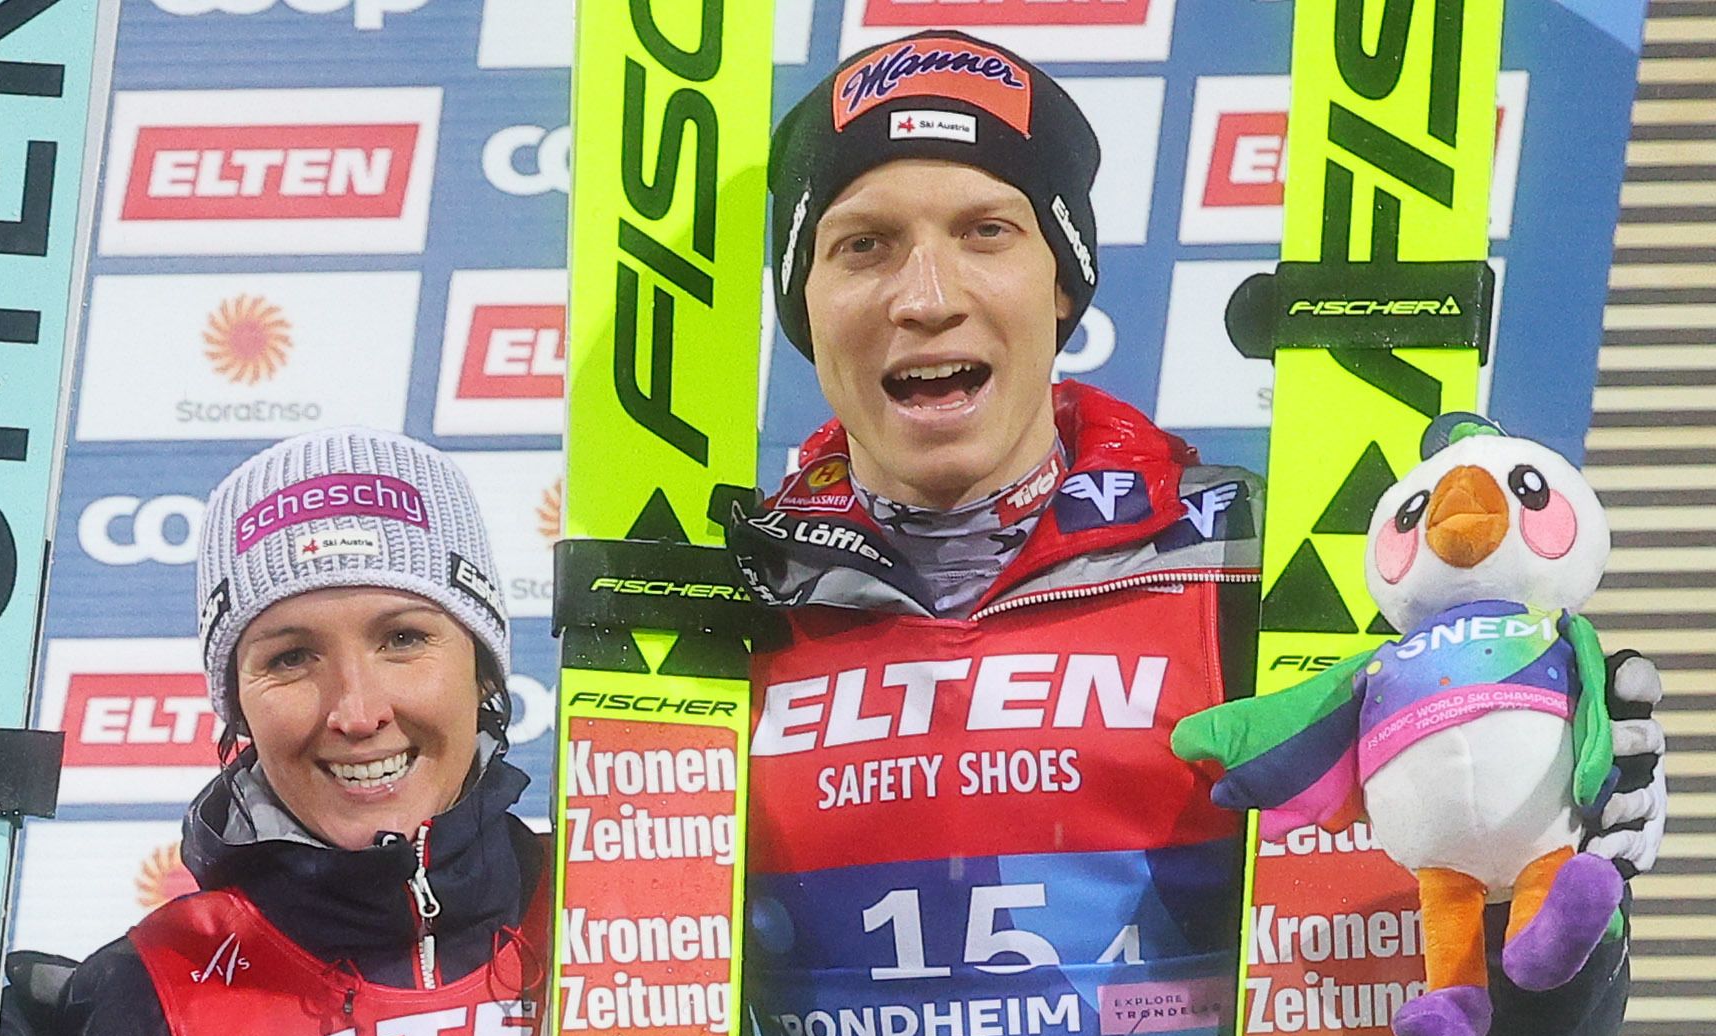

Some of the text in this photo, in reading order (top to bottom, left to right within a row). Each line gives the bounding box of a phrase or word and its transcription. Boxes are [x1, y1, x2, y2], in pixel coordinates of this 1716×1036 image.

[842, 44, 1024, 112] Manner
[919, 120, 970, 132] Ski Austria
[148, 147, 393, 197] ELTEN
[1288, 300, 1439, 316] FISCHER
[175, 400, 321, 423] StoraEnso
[78, 494, 202, 566] co
[241, 479, 427, 541] scheschy
[322, 537, 373, 548] Ski Austria
[591, 577, 734, 600] FISCHER
[80, 696, 227, 744] ELT
[568, 692, 738, 716] FISCHER
[748, 653, 1169, 758] ELTEN
[1416, 695, 1464, 717] WORLD
[1468, 692, 1490, 703] SKI
[568, 740, 736, 797] Kronen
[817, 749, 1081, 810] SAFETY SHOES
[567, 806, 738, 865] Zeitung
[561, 908, 732, 967] Kronen
[862, 884, 1062, 981] 15
[559, 973, 731, 1034] Zeitung
[1114, 994, 1183, 1008] EXPLORE
[1245, 971, 1428, 1034] Zeitun
